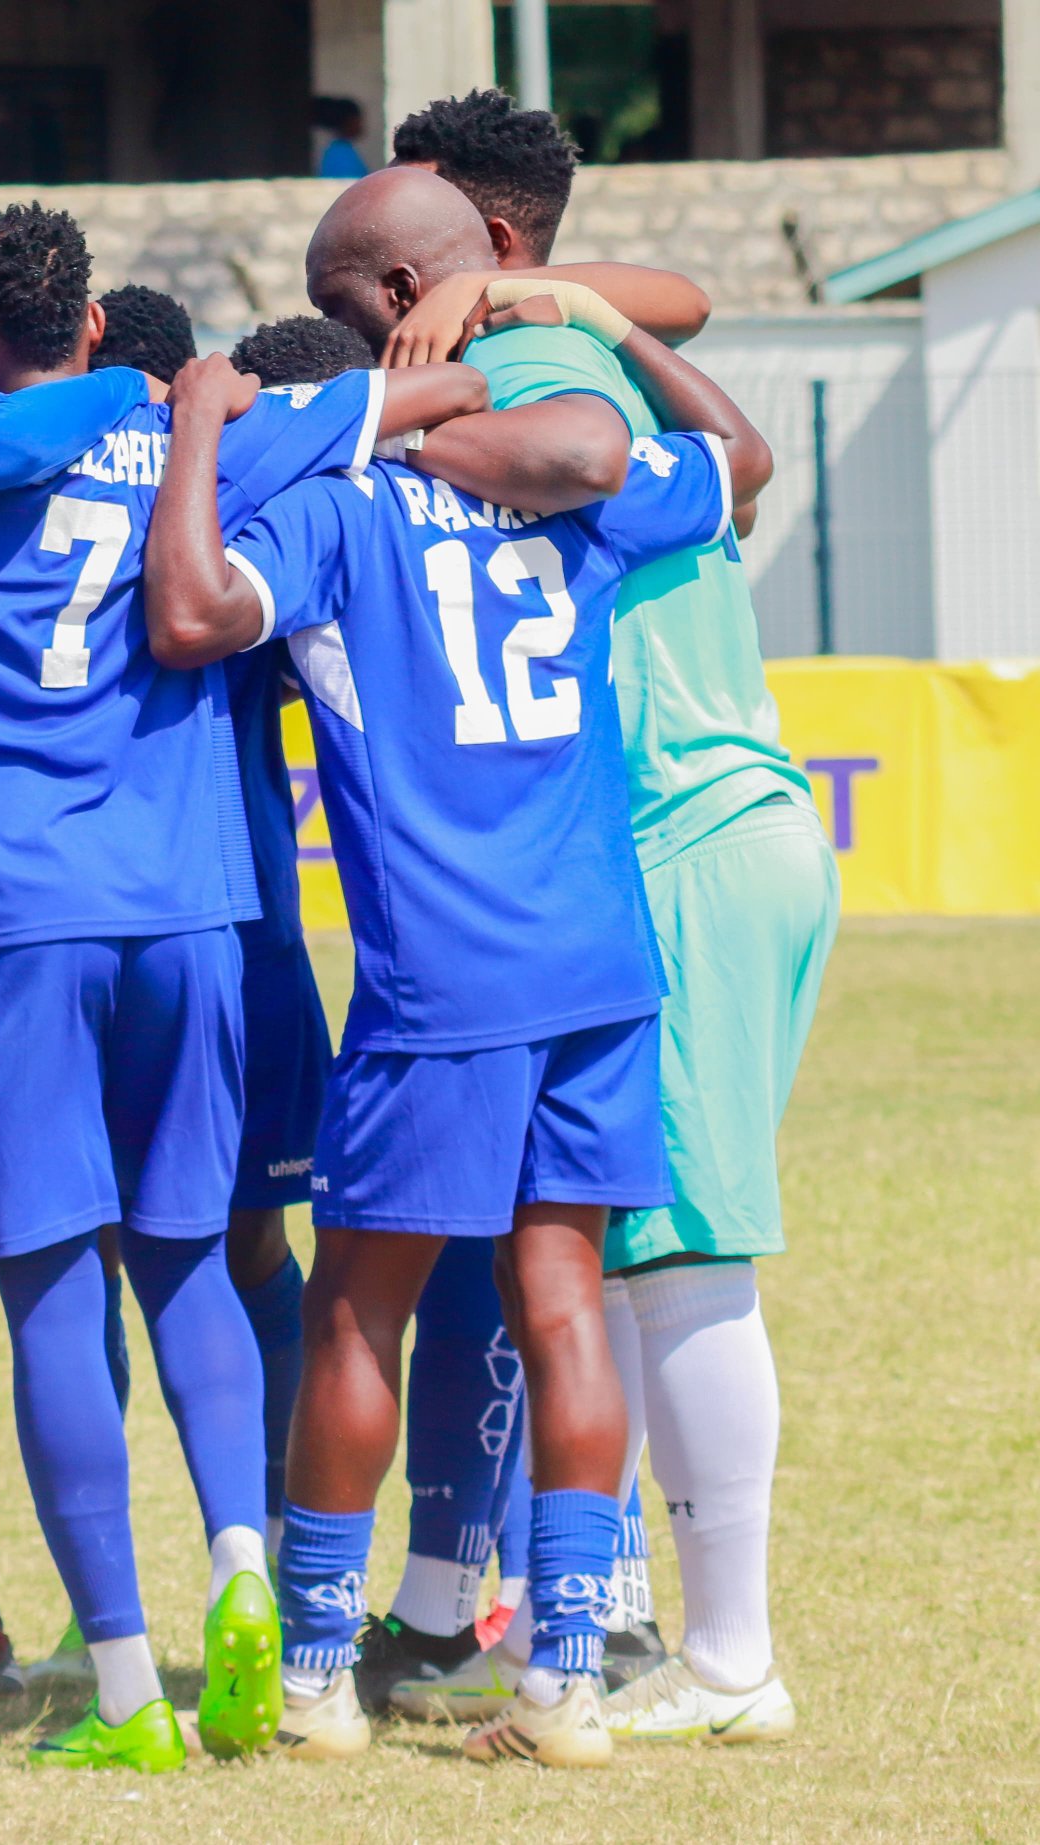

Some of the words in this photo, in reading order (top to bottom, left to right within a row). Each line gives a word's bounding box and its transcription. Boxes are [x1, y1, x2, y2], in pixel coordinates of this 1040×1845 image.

[395, 477, 557, 533] RAJ
[40, 494, 132, 688] 7
[424, 537, 581, 745] 12
[805, 758, 879, 850] T
